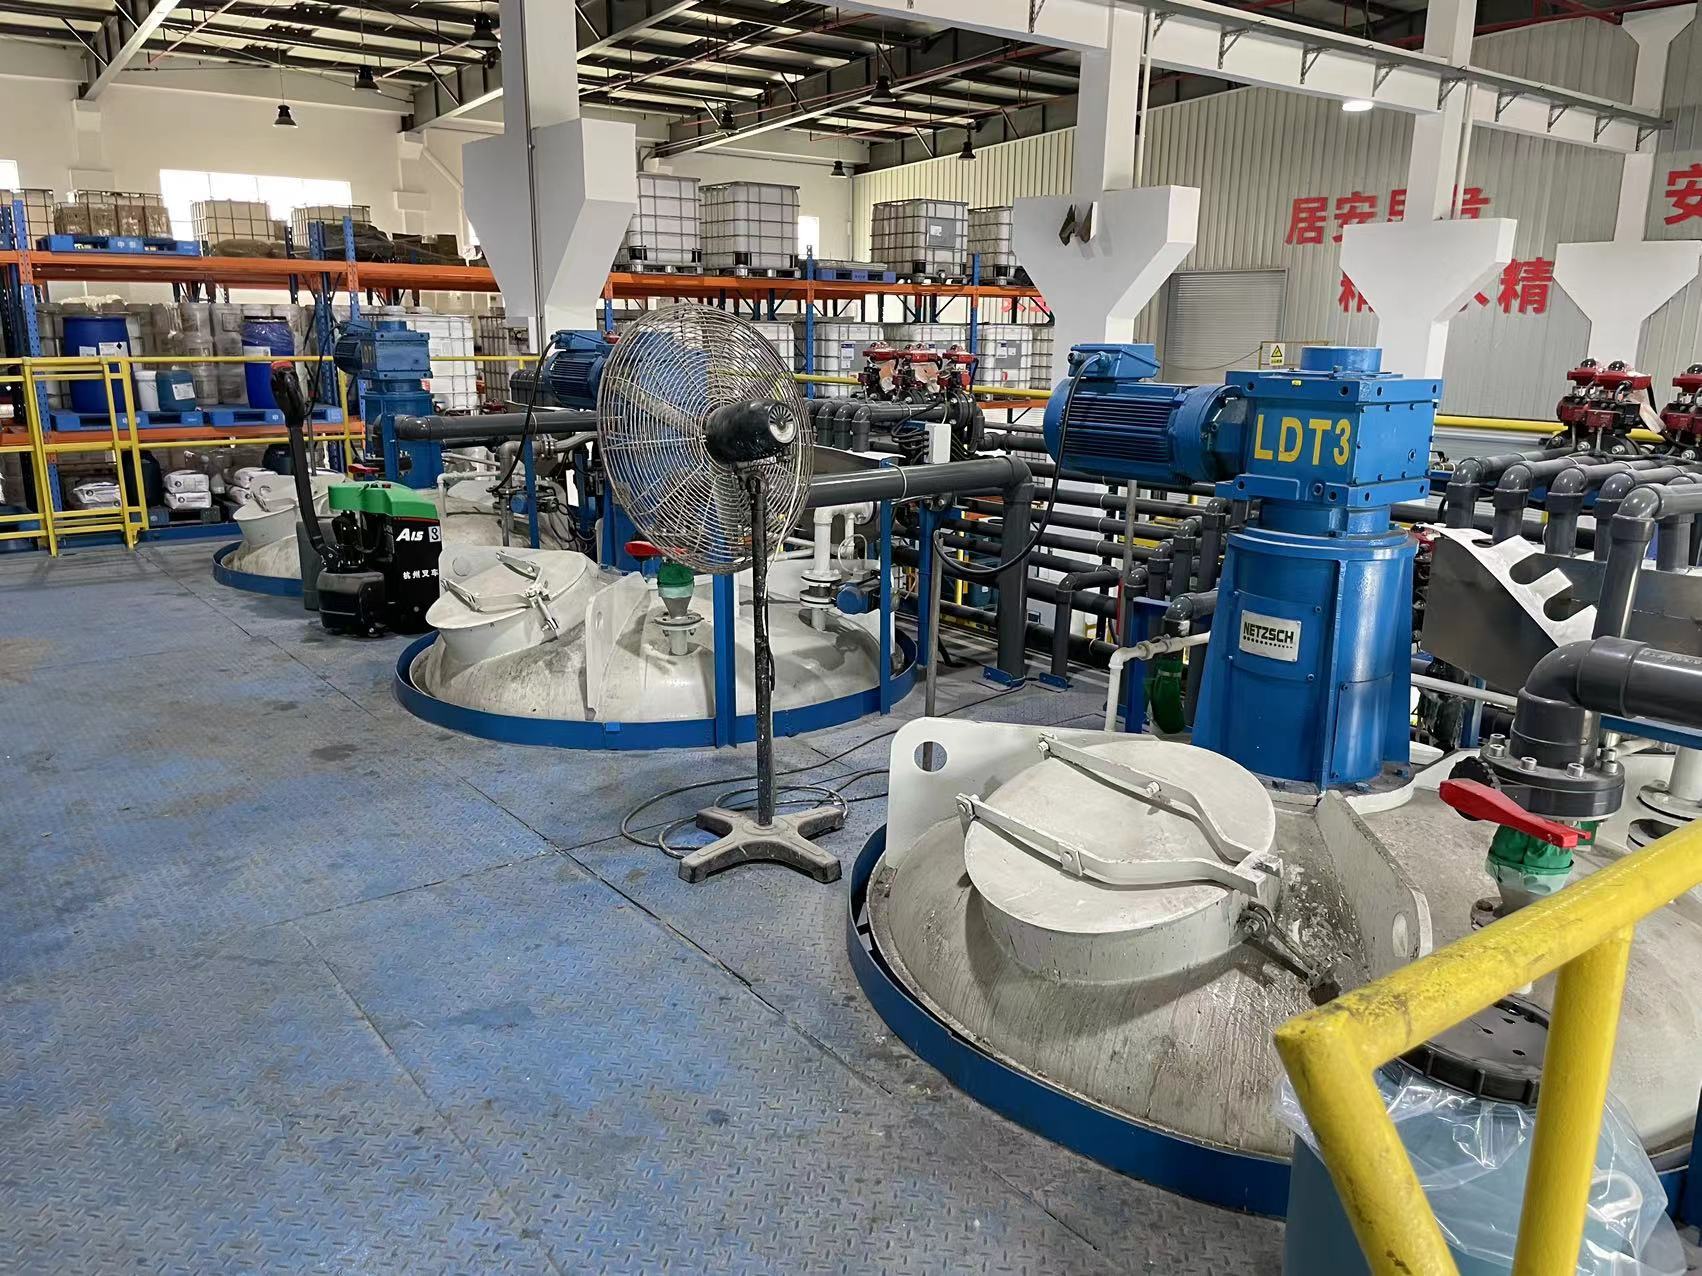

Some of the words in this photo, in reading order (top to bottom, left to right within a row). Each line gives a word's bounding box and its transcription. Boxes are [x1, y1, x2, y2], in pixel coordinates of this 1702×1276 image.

[1254, 414, 1351, 466] LDT3
[403, 568, 439, 580] 杭州叉车
[1243, 621, 1295, 645] NETZSCH
